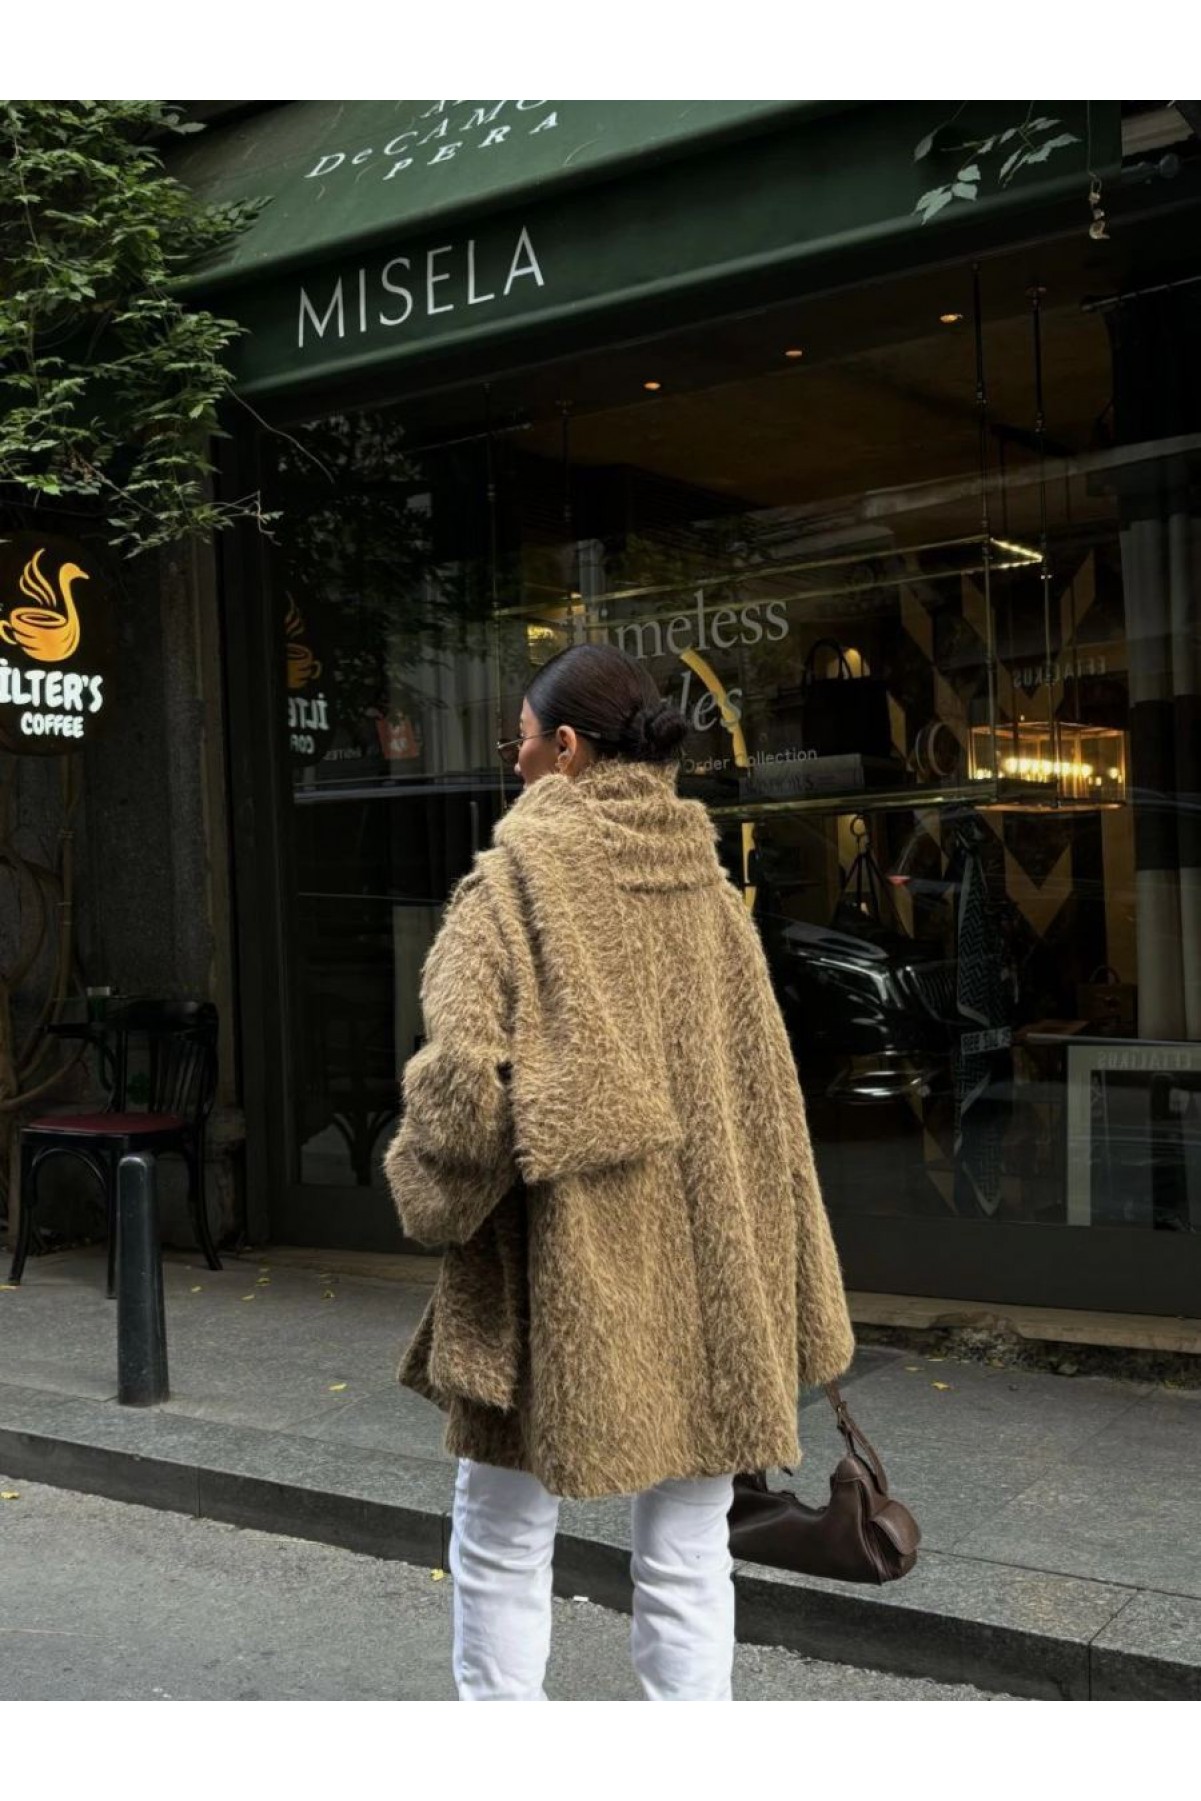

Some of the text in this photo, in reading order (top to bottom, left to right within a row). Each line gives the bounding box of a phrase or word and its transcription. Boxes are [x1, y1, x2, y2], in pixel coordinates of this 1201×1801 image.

[383, 111, 558, 180] PERA
[299, 226, 544, 348] MISELA
[20, 711, 84, 738] COFFEE
[738, 747, 818, 767] ollection
